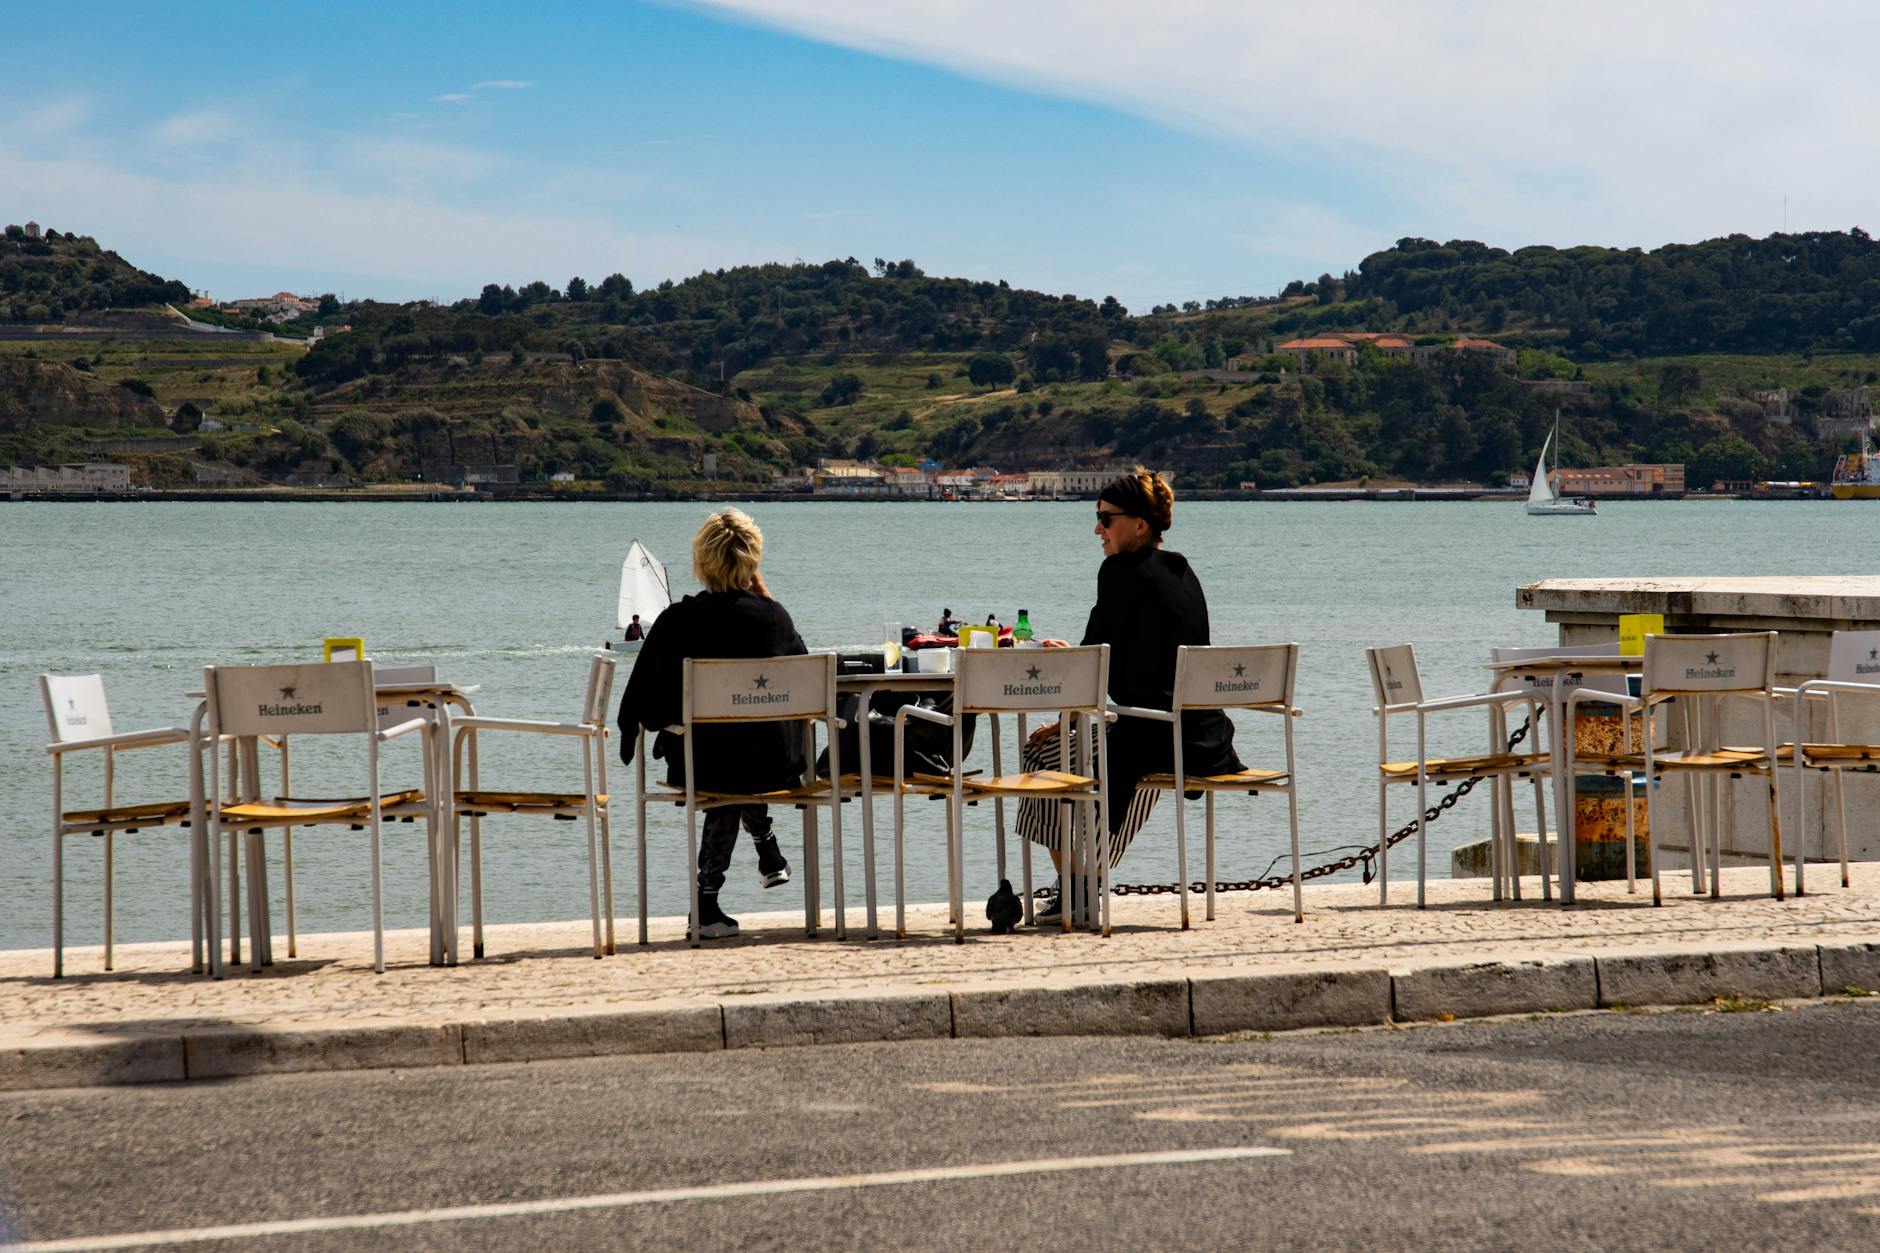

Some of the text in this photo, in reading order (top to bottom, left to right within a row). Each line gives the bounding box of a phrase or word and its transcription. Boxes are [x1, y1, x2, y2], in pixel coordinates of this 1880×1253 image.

[1685, 667, 1735, 679] Heineken
[1003, 683, 1061, 696] Heineken
[1214, 680, 1260, 692] Heineken
[731, 692, 789, 705] Heineken
[258, 703, 322, 716] Heineken
